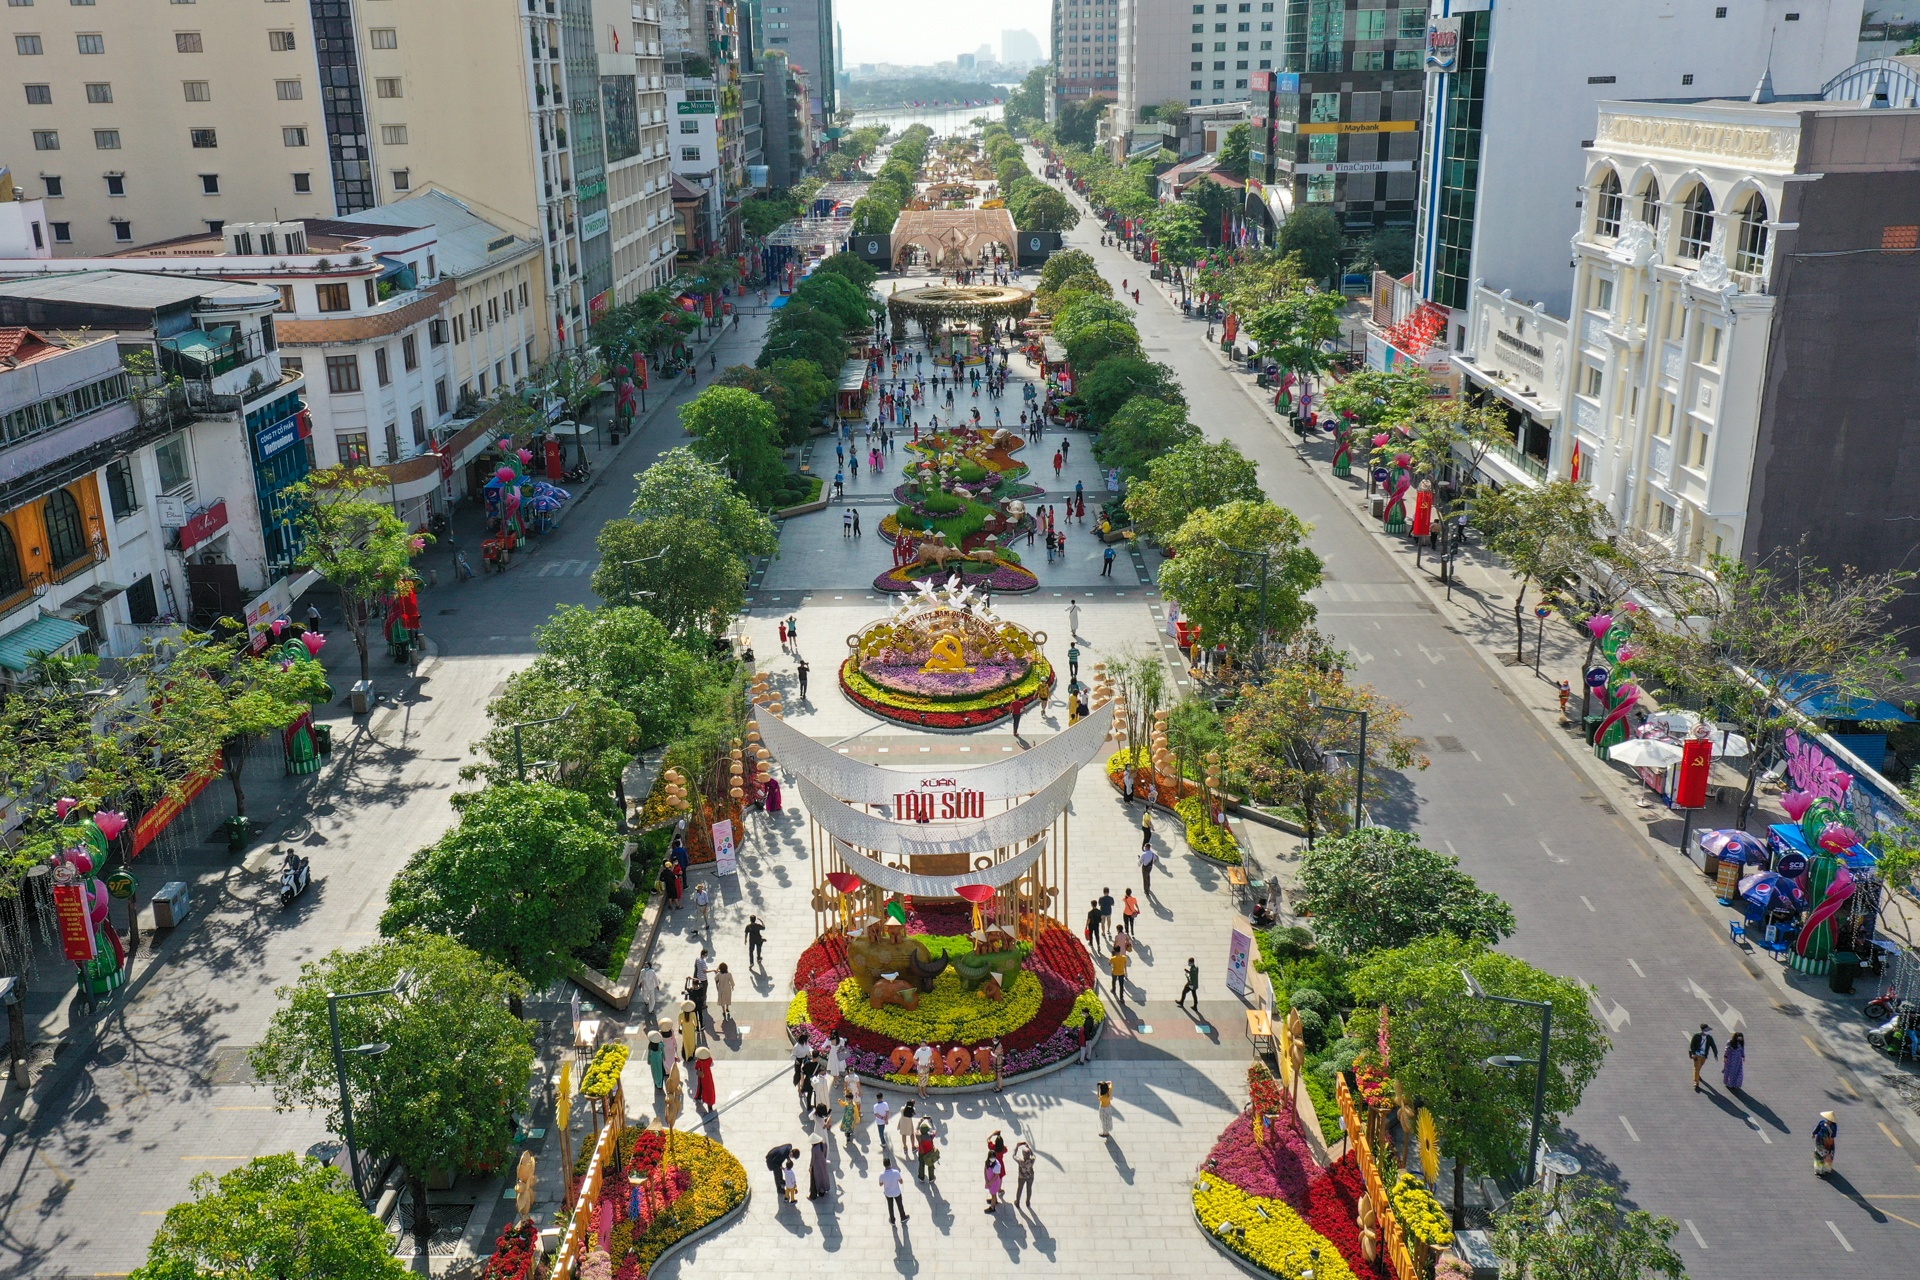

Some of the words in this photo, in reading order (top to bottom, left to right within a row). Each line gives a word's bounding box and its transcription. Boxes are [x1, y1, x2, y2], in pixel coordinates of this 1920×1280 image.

[1344, 124, 1379, 132] Maybank
[1335, 162, 1383, 172] VinaCapital
[921, 778, 956, 787] XUÂN
[893, 790, 934, 820] TÂN
[942, 788, 984, 819] SỬU
[1789, 861, 1804, 869] SCB
